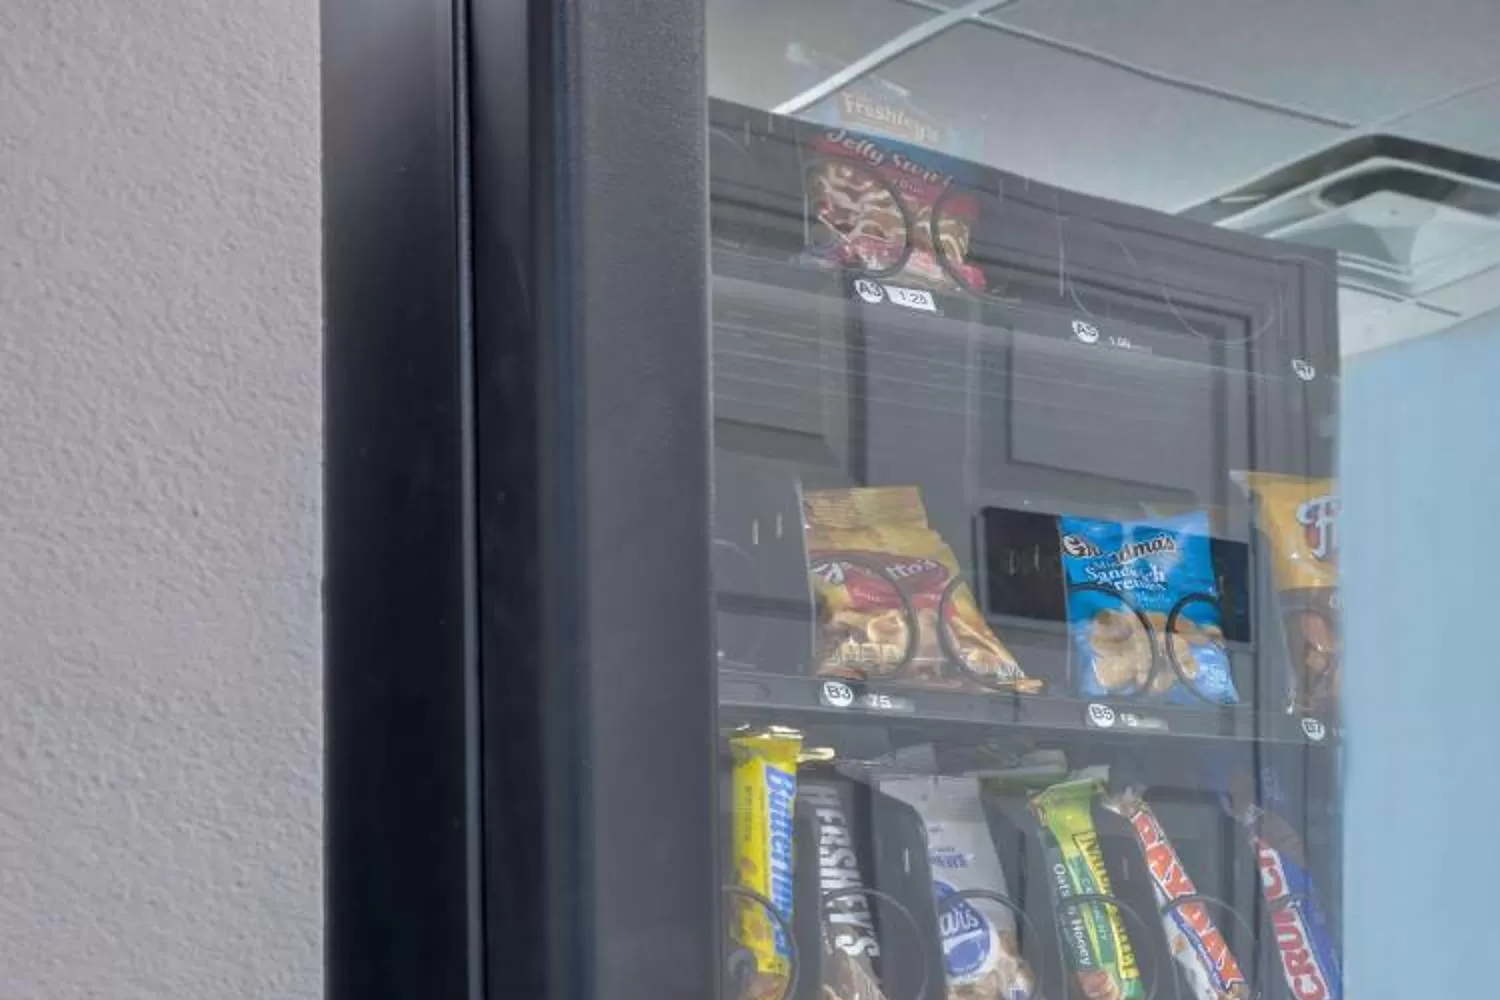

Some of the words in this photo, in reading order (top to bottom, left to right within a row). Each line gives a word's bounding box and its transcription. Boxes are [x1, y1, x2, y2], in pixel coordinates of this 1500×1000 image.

[1063, 534, 1176, 564] Grdma's
[1085, 563, 1165, 586] Sandwh
[826, 684, 850, 699] B3
[1090, 705, 1114, 721] B5
